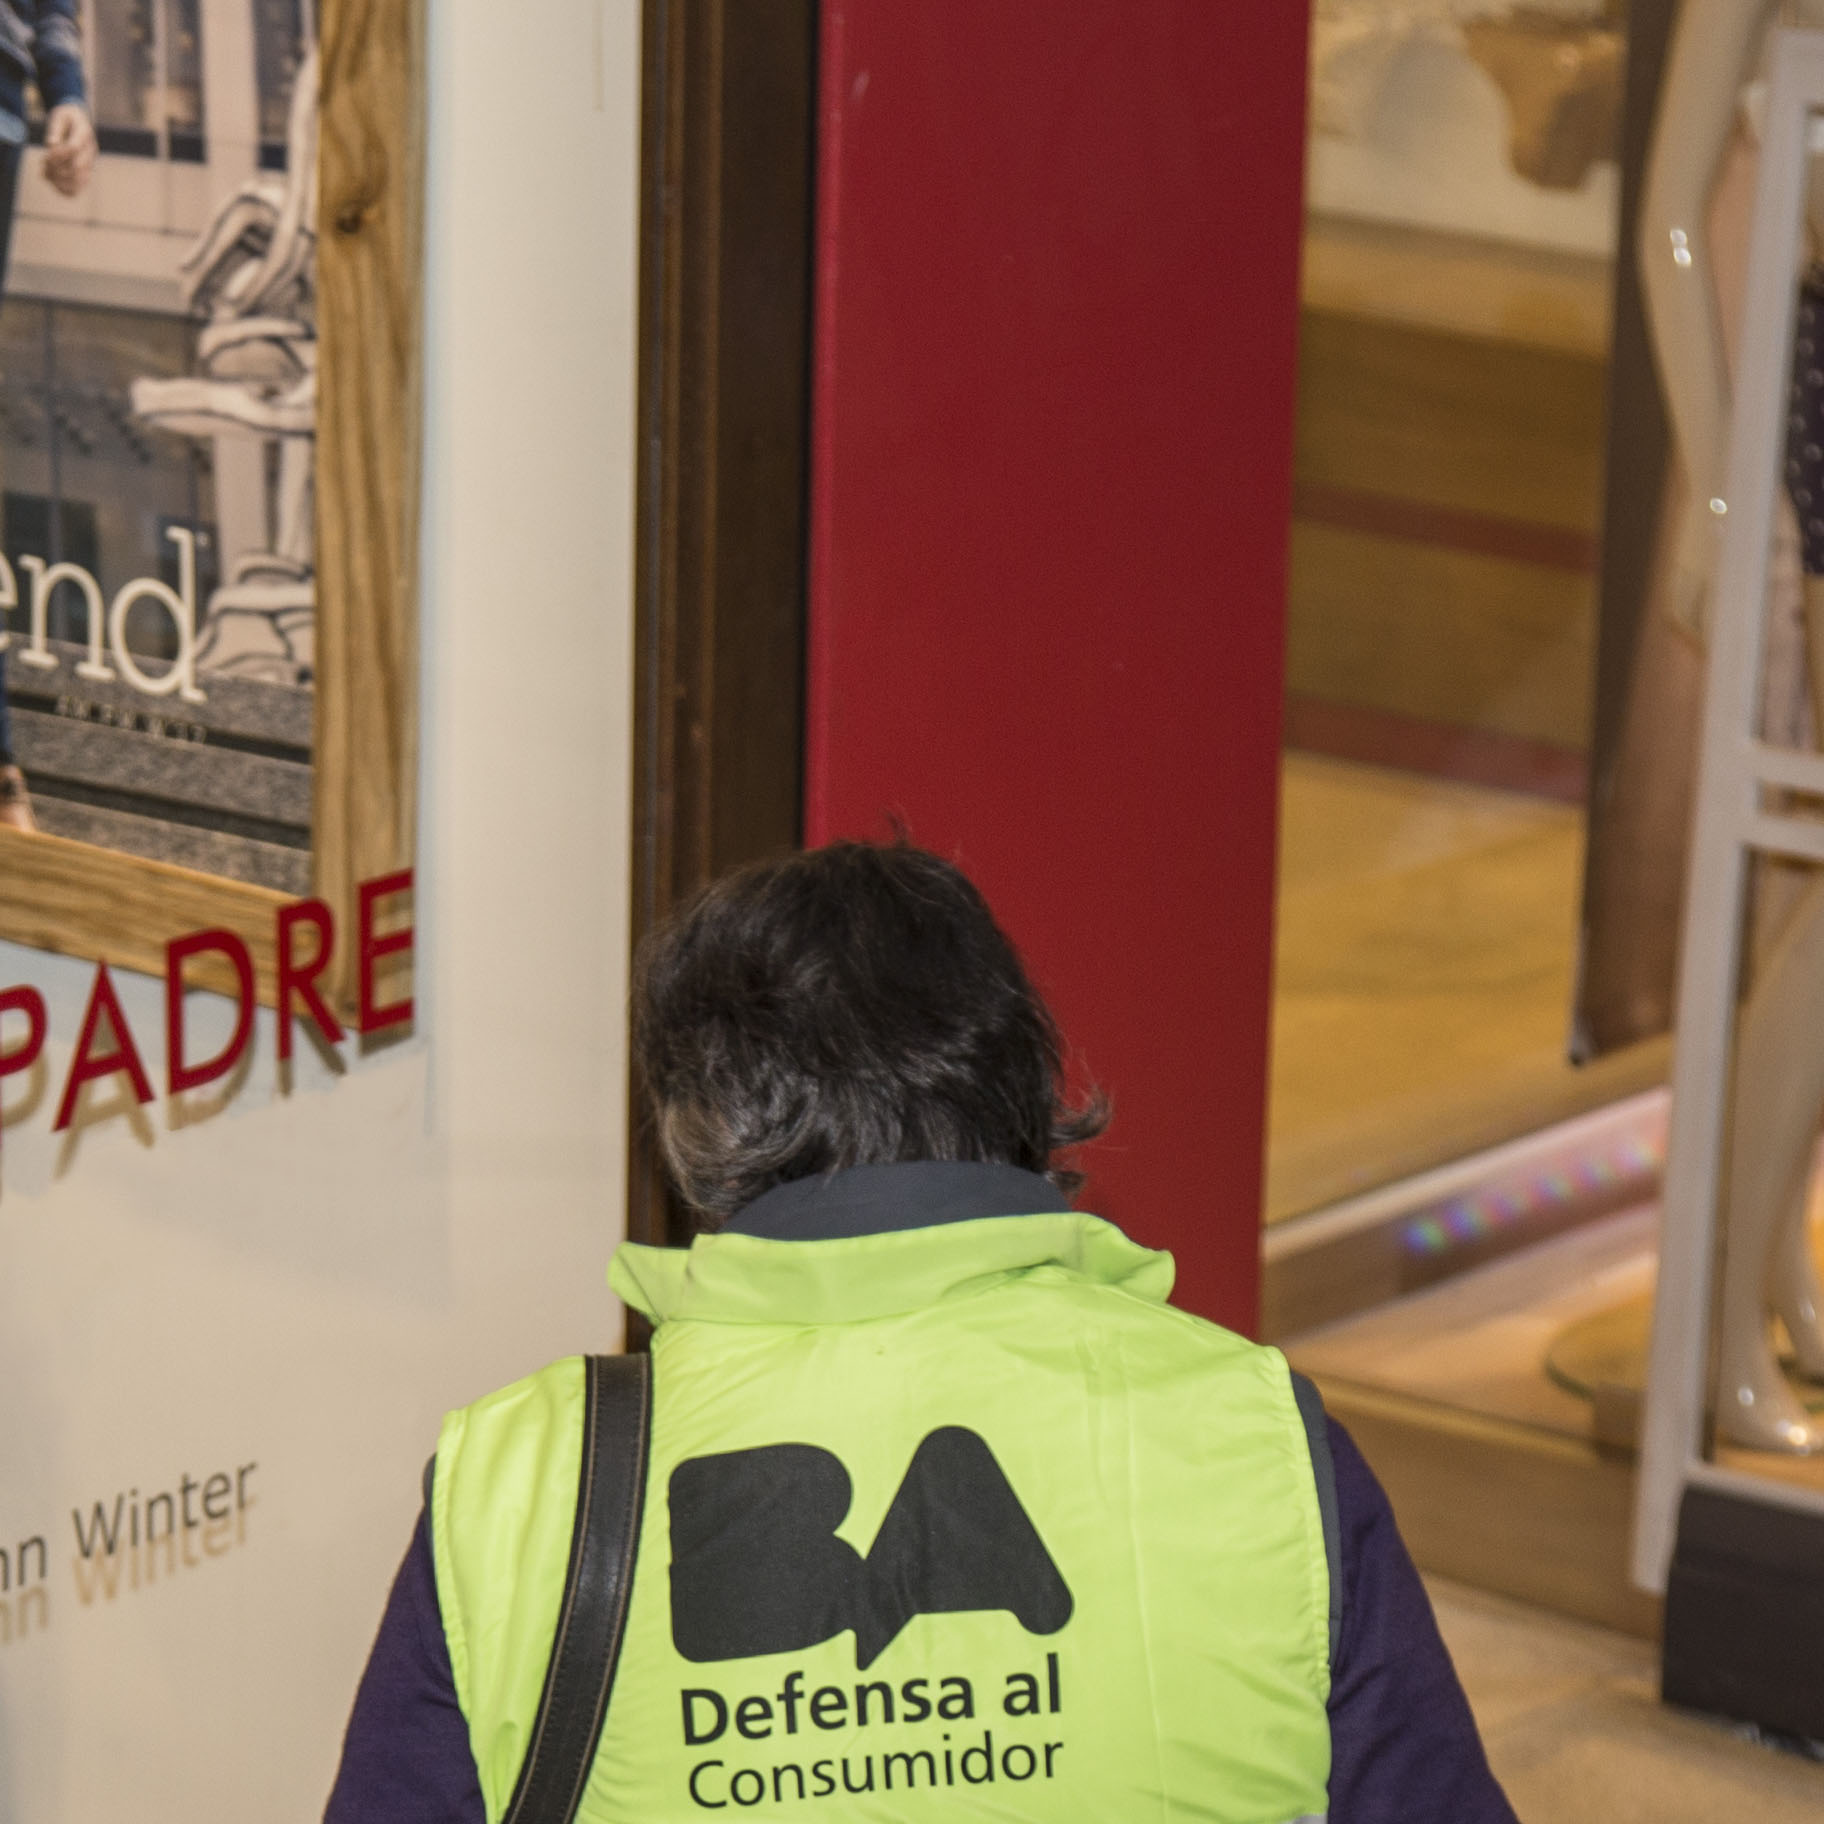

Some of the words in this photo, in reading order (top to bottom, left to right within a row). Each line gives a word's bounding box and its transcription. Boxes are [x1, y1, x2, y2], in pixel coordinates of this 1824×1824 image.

[73, 1461, 257, 1562] Winter
[668, 1424, 1074, 1671] BA
[680, 1670, 975, 1746] Defensa
[1003, 1652, 1062, 1716] al
[688, 1729, 1065, 1809] Consumidor
